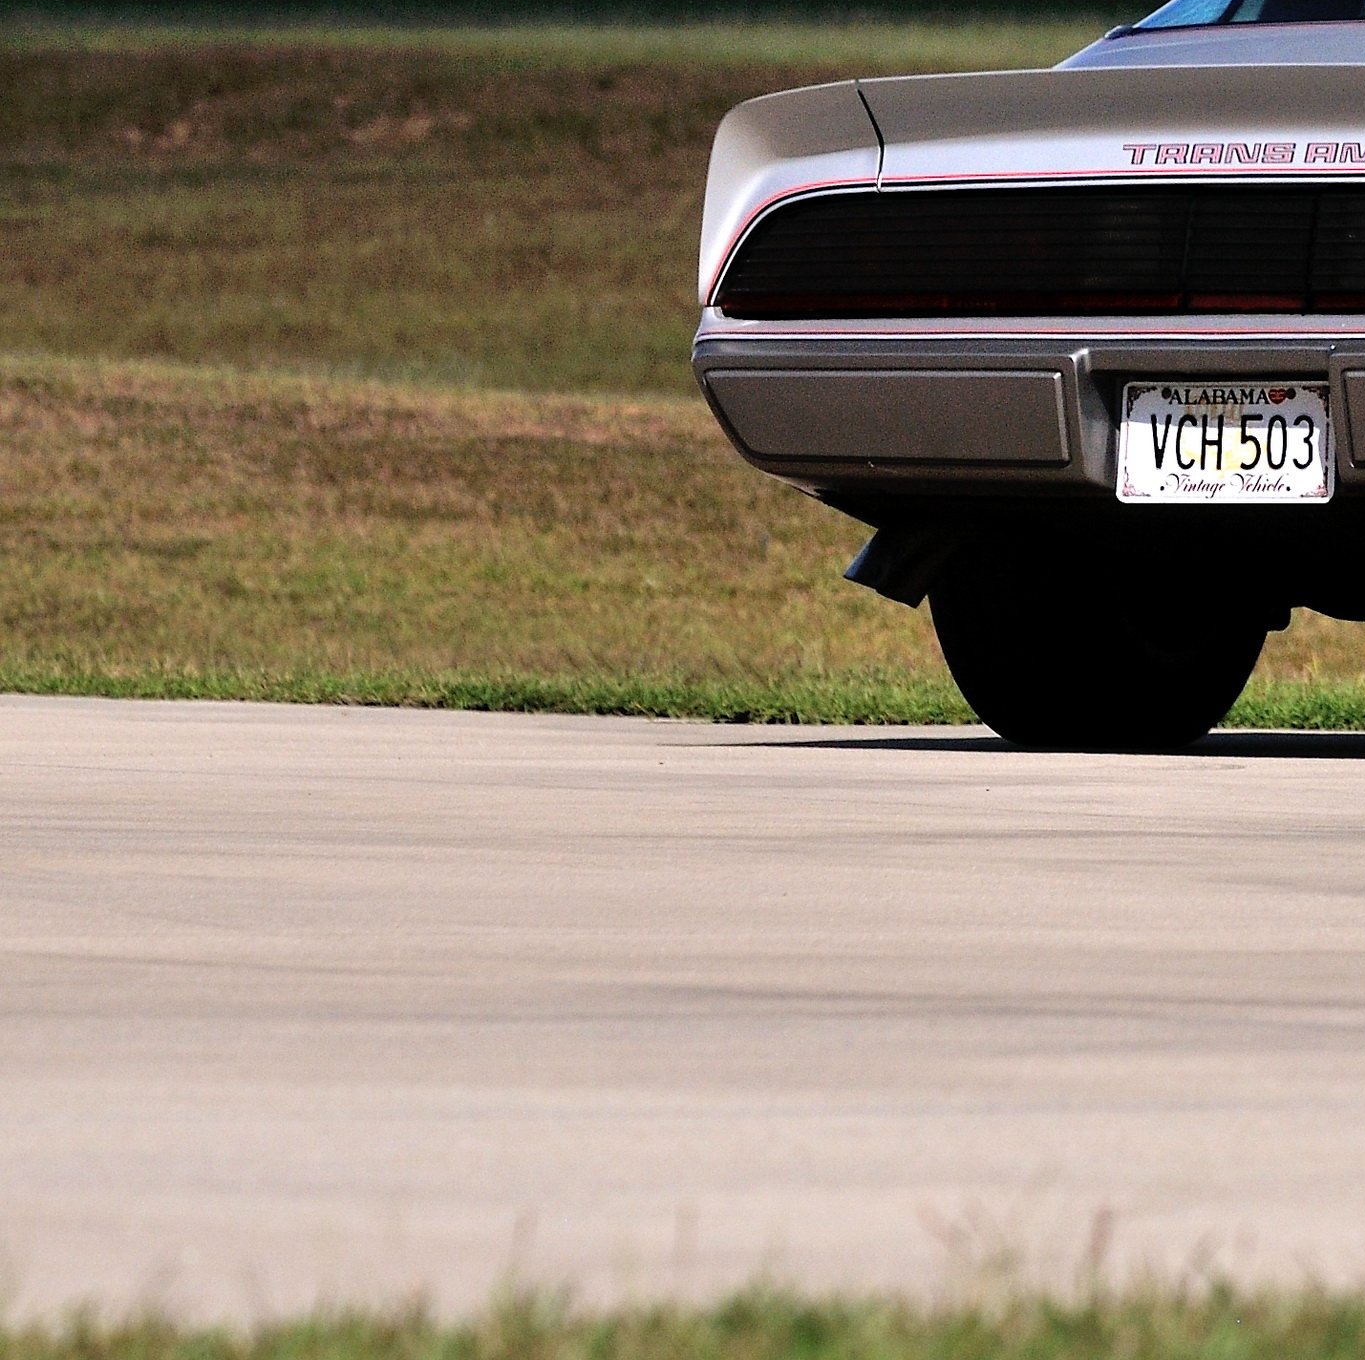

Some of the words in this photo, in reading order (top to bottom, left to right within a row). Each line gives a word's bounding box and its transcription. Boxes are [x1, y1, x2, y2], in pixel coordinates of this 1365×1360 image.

[1123, 143, 1296, 164] TRANS
[1168, 388, 1270, 405] ALABAMA
[1151, 414, 1225, 470] VCH
[1240, 414, 1315, 470] 503
[1164, 473, 1226, 498] Vintage
[1229, 473, 1286, 492] Vehicle
